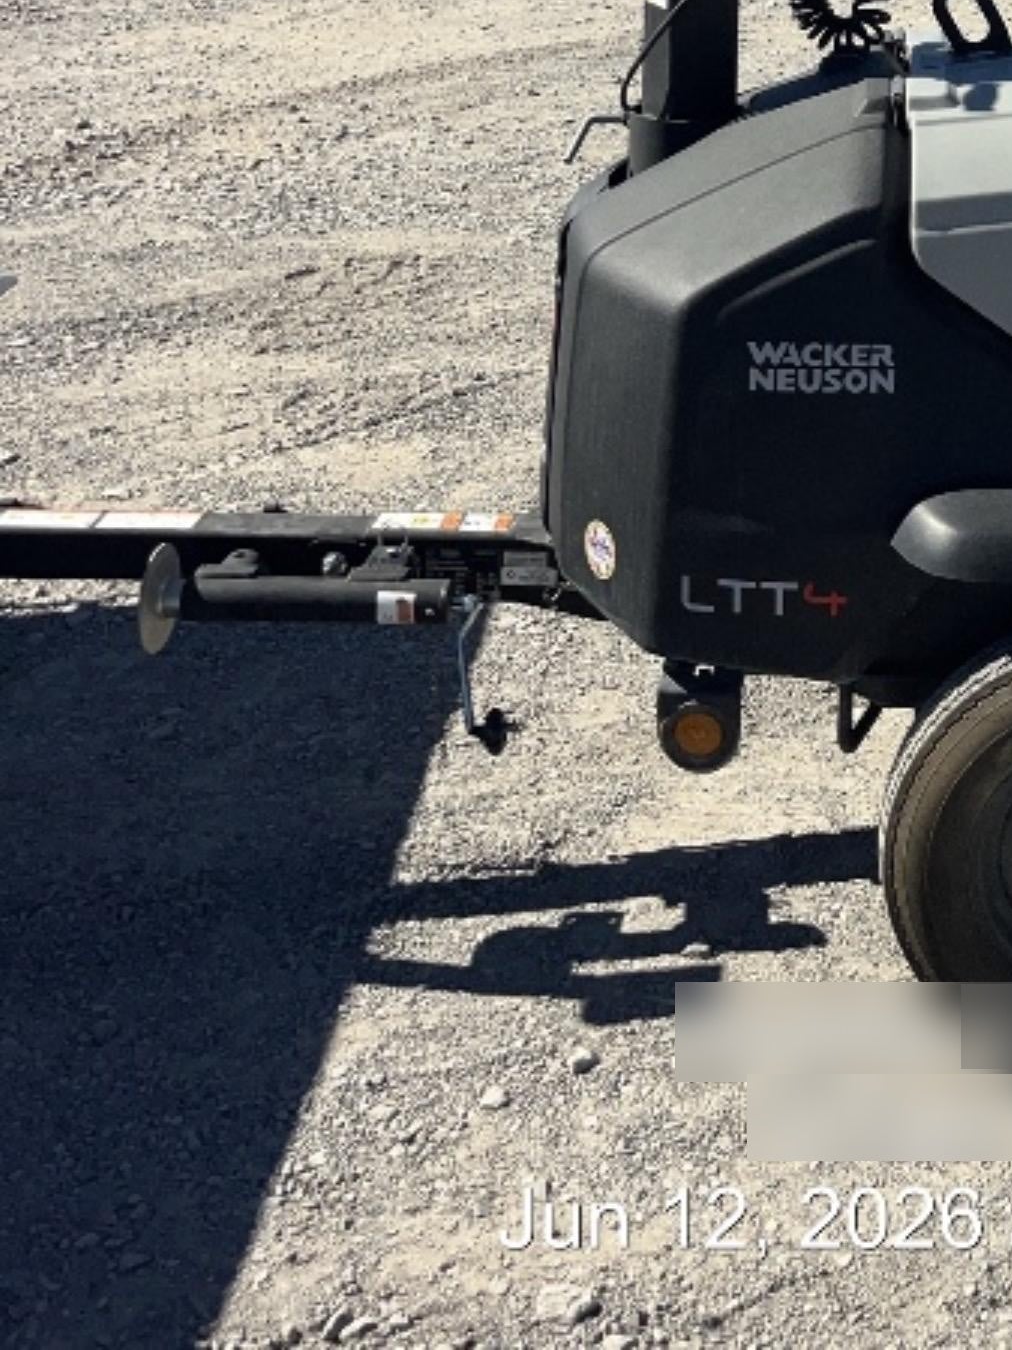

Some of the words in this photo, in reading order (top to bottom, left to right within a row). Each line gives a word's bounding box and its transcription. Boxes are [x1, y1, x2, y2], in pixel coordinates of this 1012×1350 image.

[746, 341, 895, 367] WACKER
[749, 367, 895, 394] NEUSON
[680, 575, 848, 617] LTT4
